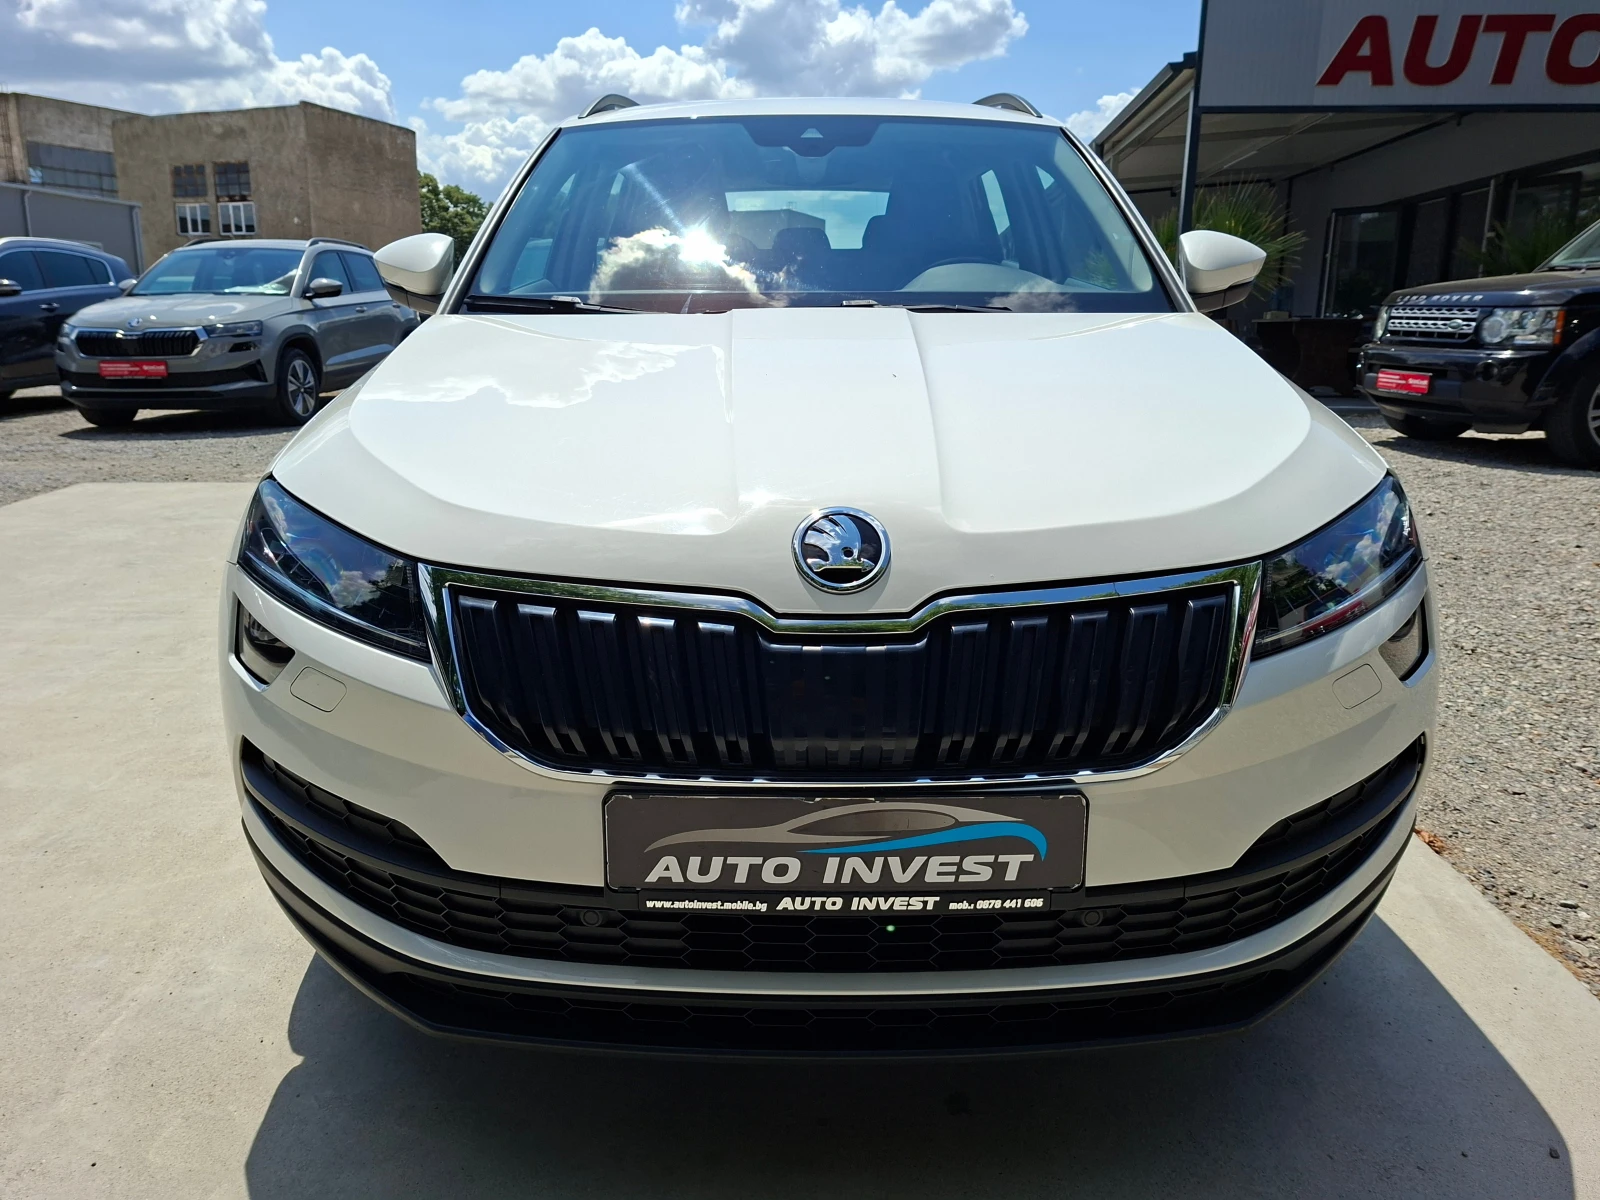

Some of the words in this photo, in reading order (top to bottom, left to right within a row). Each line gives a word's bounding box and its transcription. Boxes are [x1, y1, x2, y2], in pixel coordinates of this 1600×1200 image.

[1315, 13, 1600, 86] AUTO
[1396, 294, 1428, 303] LAND
[1430, 294, 1484, 302] ROVER
[644, 856, 801, 883] AUTO
[823, 854, 1035, 883] INVEST
[645, 899, 768, 912] www.autoinvest.mobile.bg
[775, 896, 844, 910] AUTO
[850, 896, 941, 910] INVEST
[975, 899, 1002, 909] 0878
[1002, 898, 1022, 909] 441
